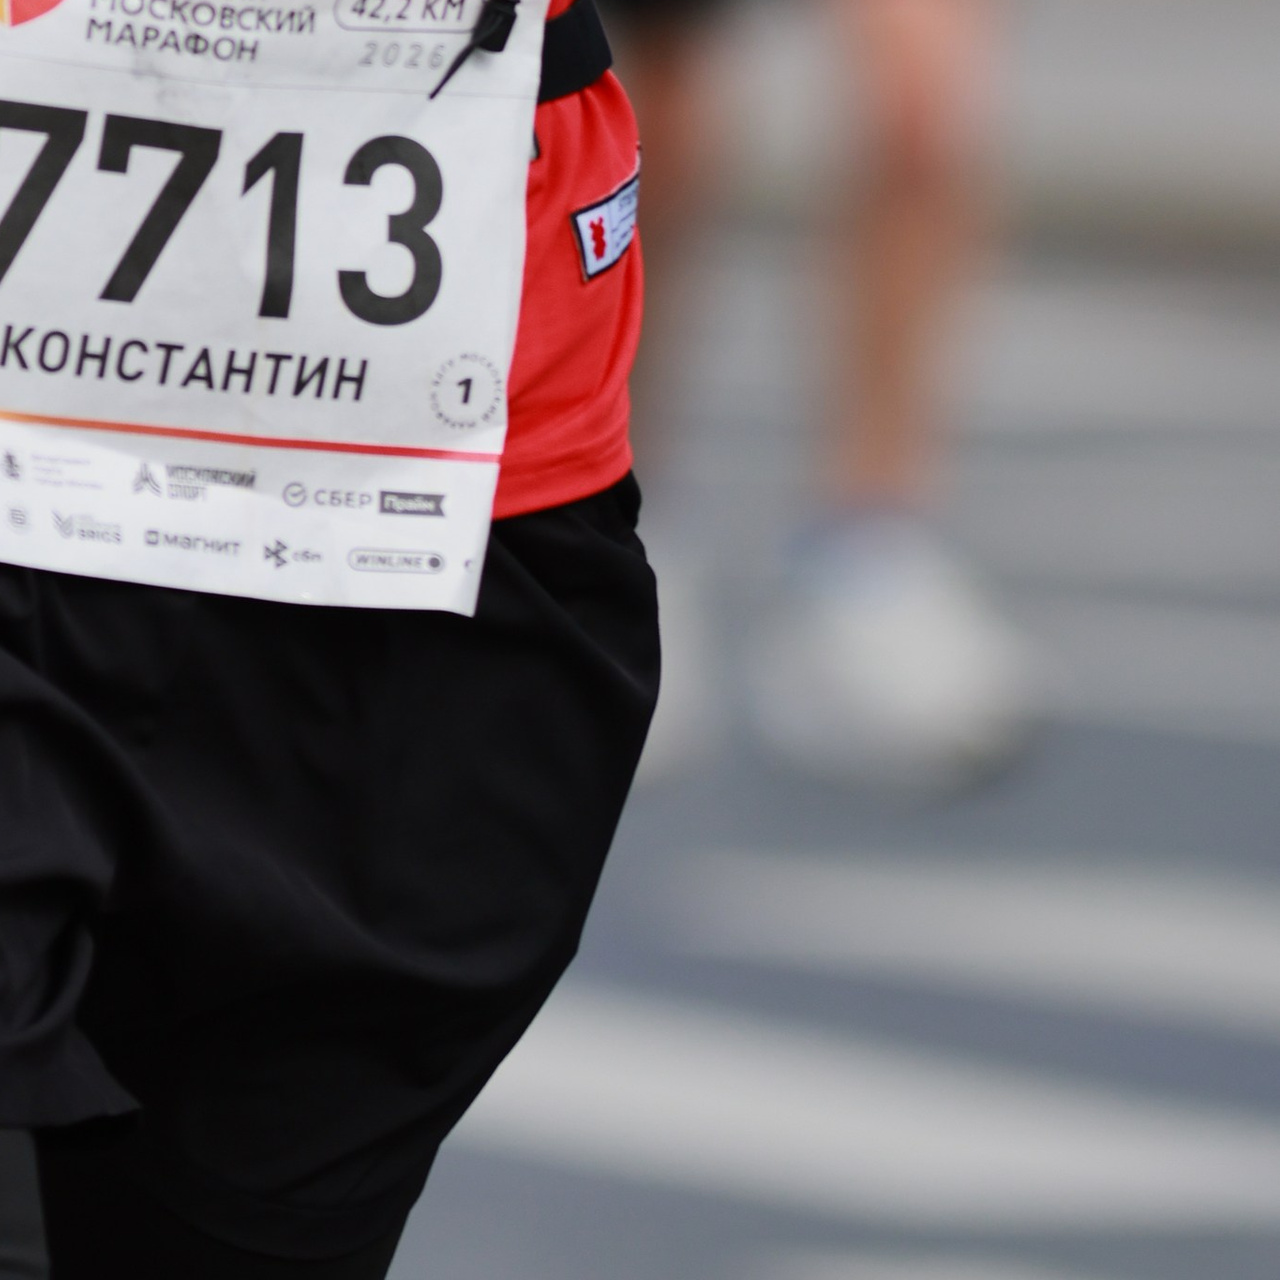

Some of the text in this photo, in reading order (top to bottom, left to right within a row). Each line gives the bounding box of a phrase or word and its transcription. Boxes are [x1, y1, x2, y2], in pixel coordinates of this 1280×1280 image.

[86, 18, 260, 62] МАРАФОН
[457, 378, 472, 404] 1
[314, 489, 372, 509] СБЕР
[355, 553, 423, 567] WINLINE
